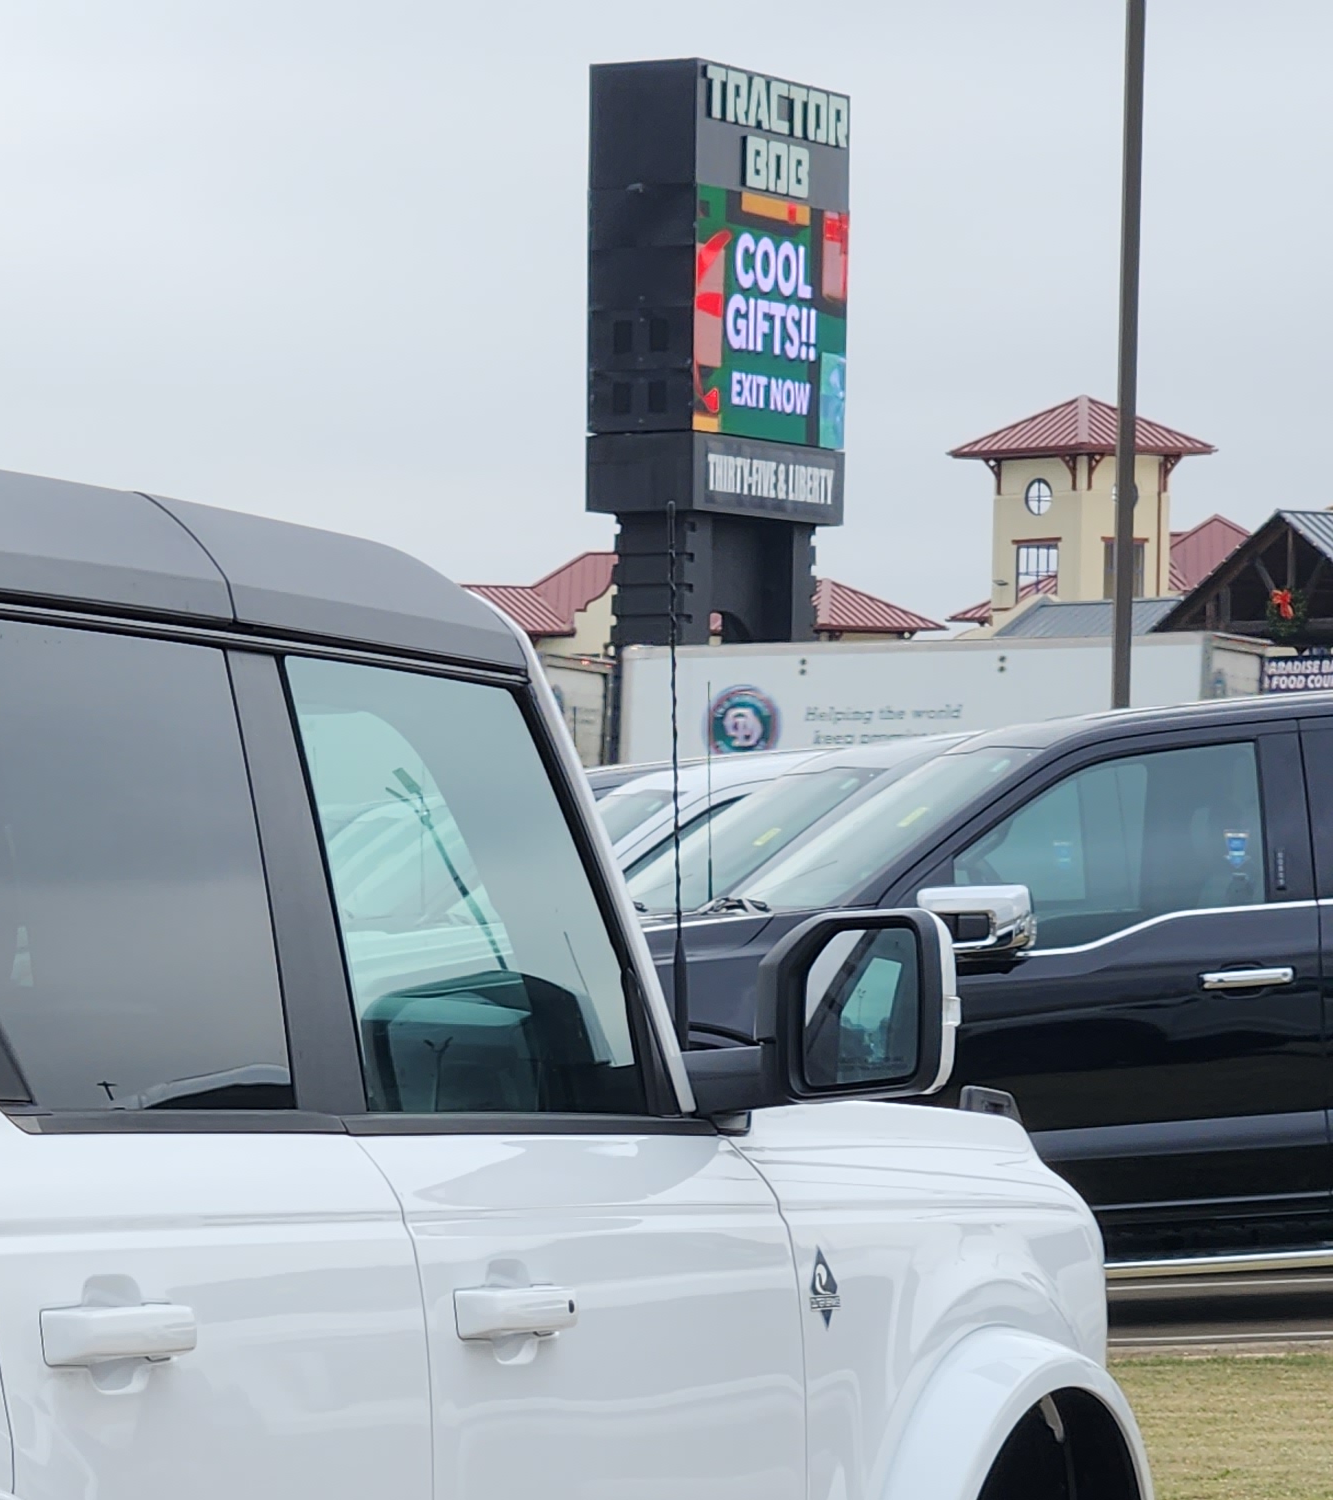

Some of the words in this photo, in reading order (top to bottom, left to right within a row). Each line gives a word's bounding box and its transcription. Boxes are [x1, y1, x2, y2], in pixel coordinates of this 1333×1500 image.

[706, 64, 848, 148] TRACTOR
[745, 135, 810, 198] BOB
[735, 232, 812, 299] COOL
[725, 294, 817, 362] GIFTS!!
[731, 371, 768, 408] EXIT
[769, 378, 811, 415] NOW
[707, 453, 776, 499] THIRTY-FIVE
[777, 463, 787, 500] &
[788, 464, 835, 504] LIBERTY
[1271, 675, 1306, 689] FOOD
[805, 706, 874, 724] Helping
[879, 706, 906, 720] the
[912, 704, 964, 719] world
